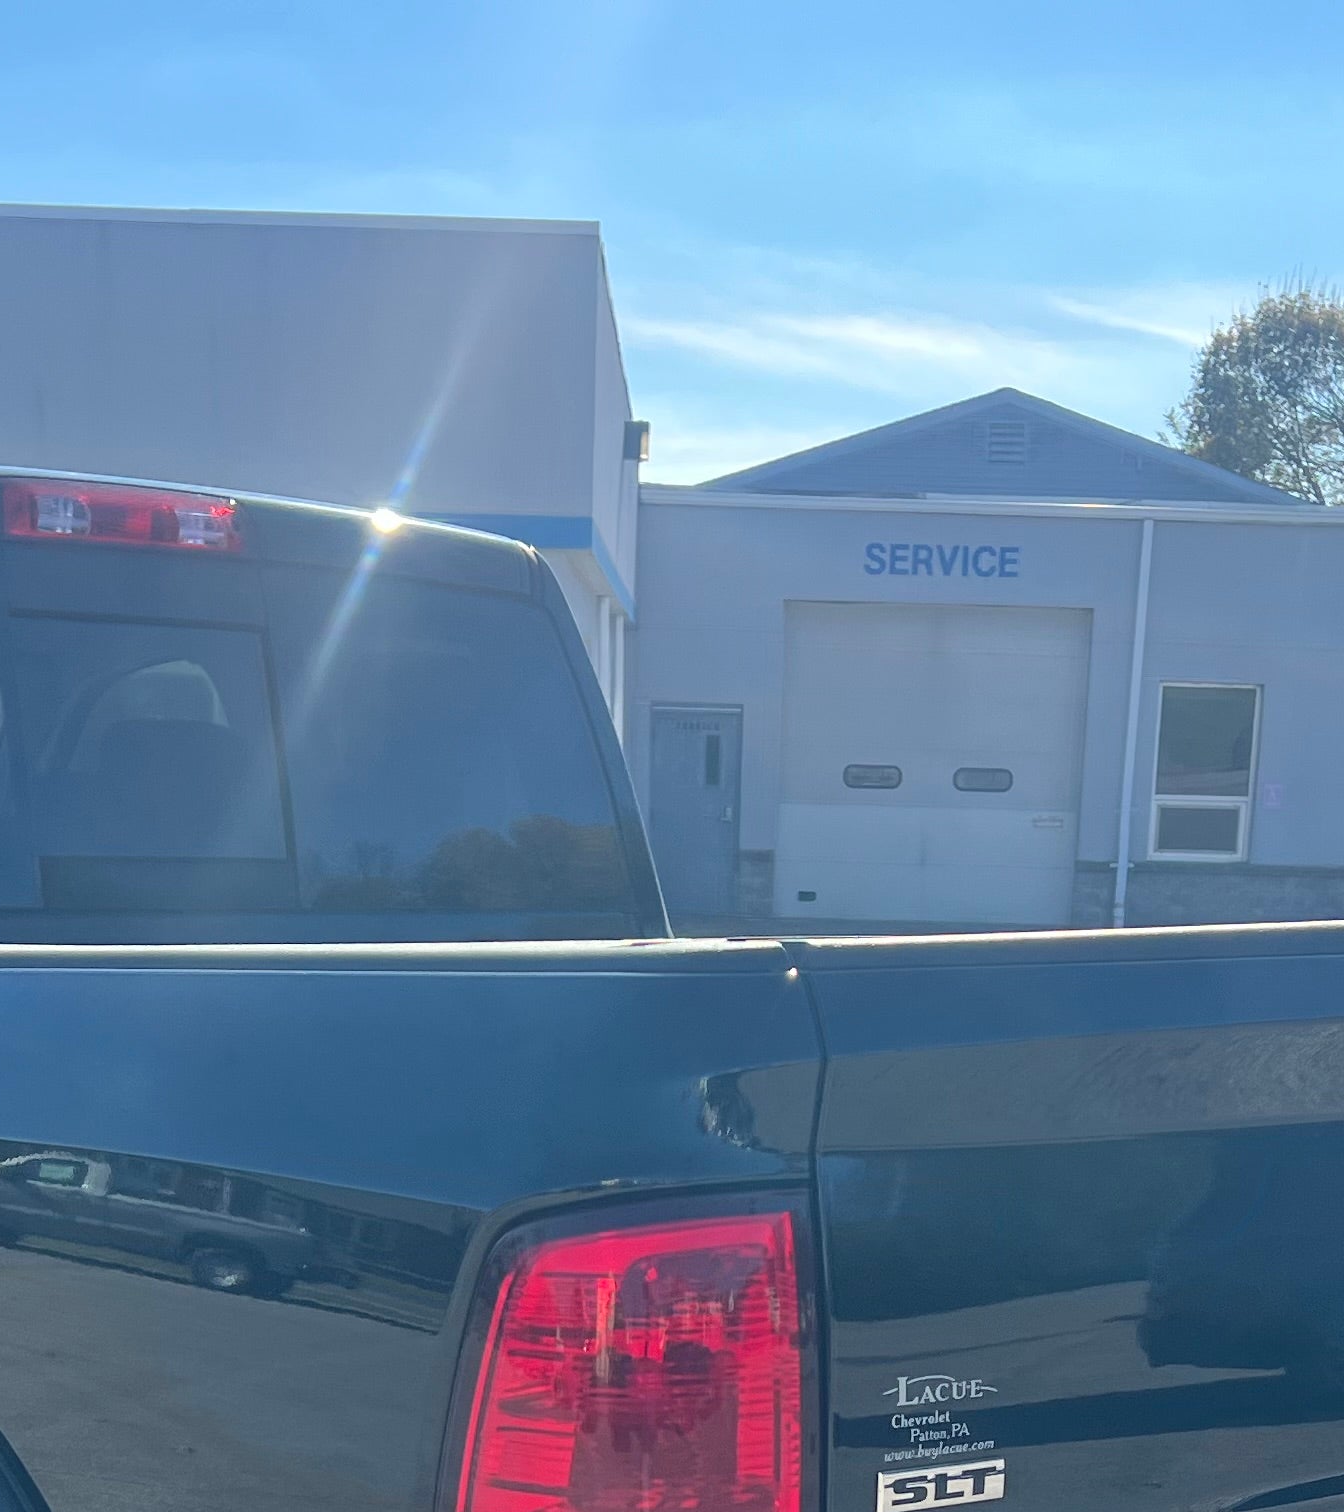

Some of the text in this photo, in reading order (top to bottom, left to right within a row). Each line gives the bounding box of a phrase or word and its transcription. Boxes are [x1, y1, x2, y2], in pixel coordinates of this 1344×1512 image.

[864, 542, 1020, 578] SERVICE
[891, 1409, 951, 1429] Chevrolet
[884, 1439, 995, 1463] www.buylacue.com
[885, 1466, 1004, 1507] SLT
